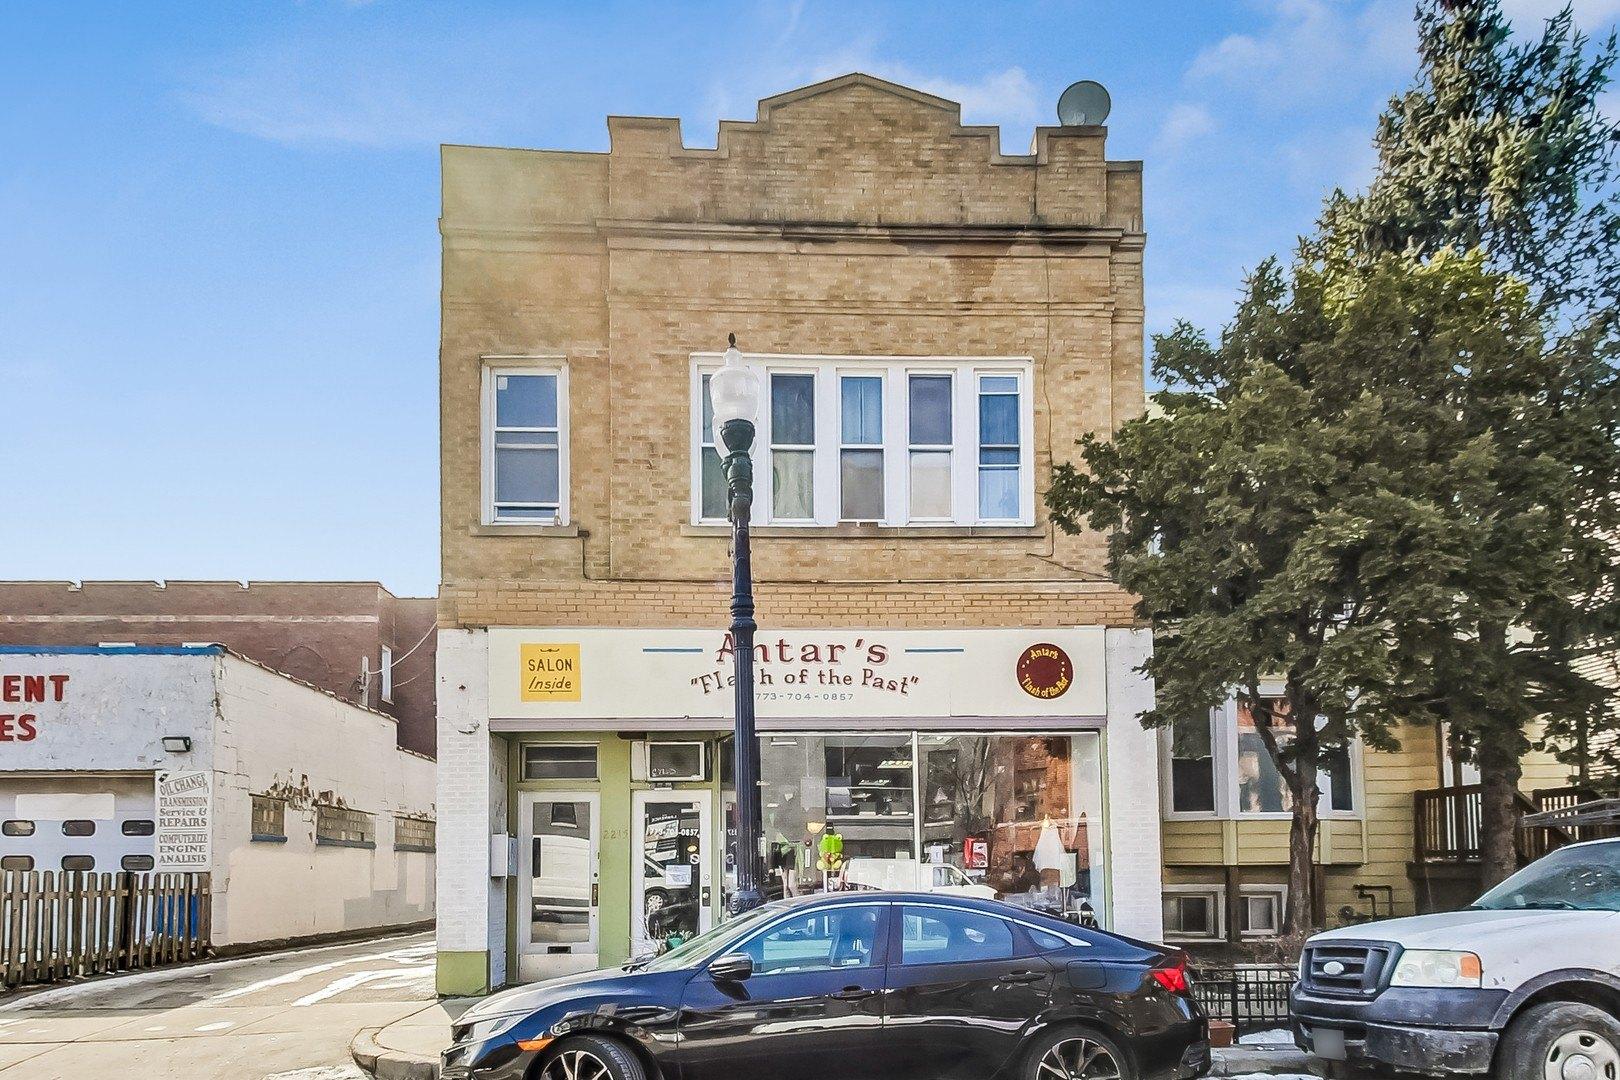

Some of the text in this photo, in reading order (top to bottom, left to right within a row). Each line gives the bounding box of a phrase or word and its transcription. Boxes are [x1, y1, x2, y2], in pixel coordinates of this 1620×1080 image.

[715, 633, 889, 665] Antar's
[528, 658, 572, 671] SALON
[528, 676, 572, 689] Inside
[690, 668, 773, 695] "Flah
[784, 669, 808, 684] of
[818, 671, 852, 685] the
[756, 692, 854, 701] 773-704-0857
[159, 774, 207, 796] OIL CHANGE
[159, 797, 208, 806] TRANSMISSION
[159, 808, 196, 816] Service
[159, 818, 207, 827] REPAIRS
[159, 834, 208, 843] COMPUTERIZE
[159, 845, 206, 853] ENGINE
[159, 855, 207, 863] ANALISIS
